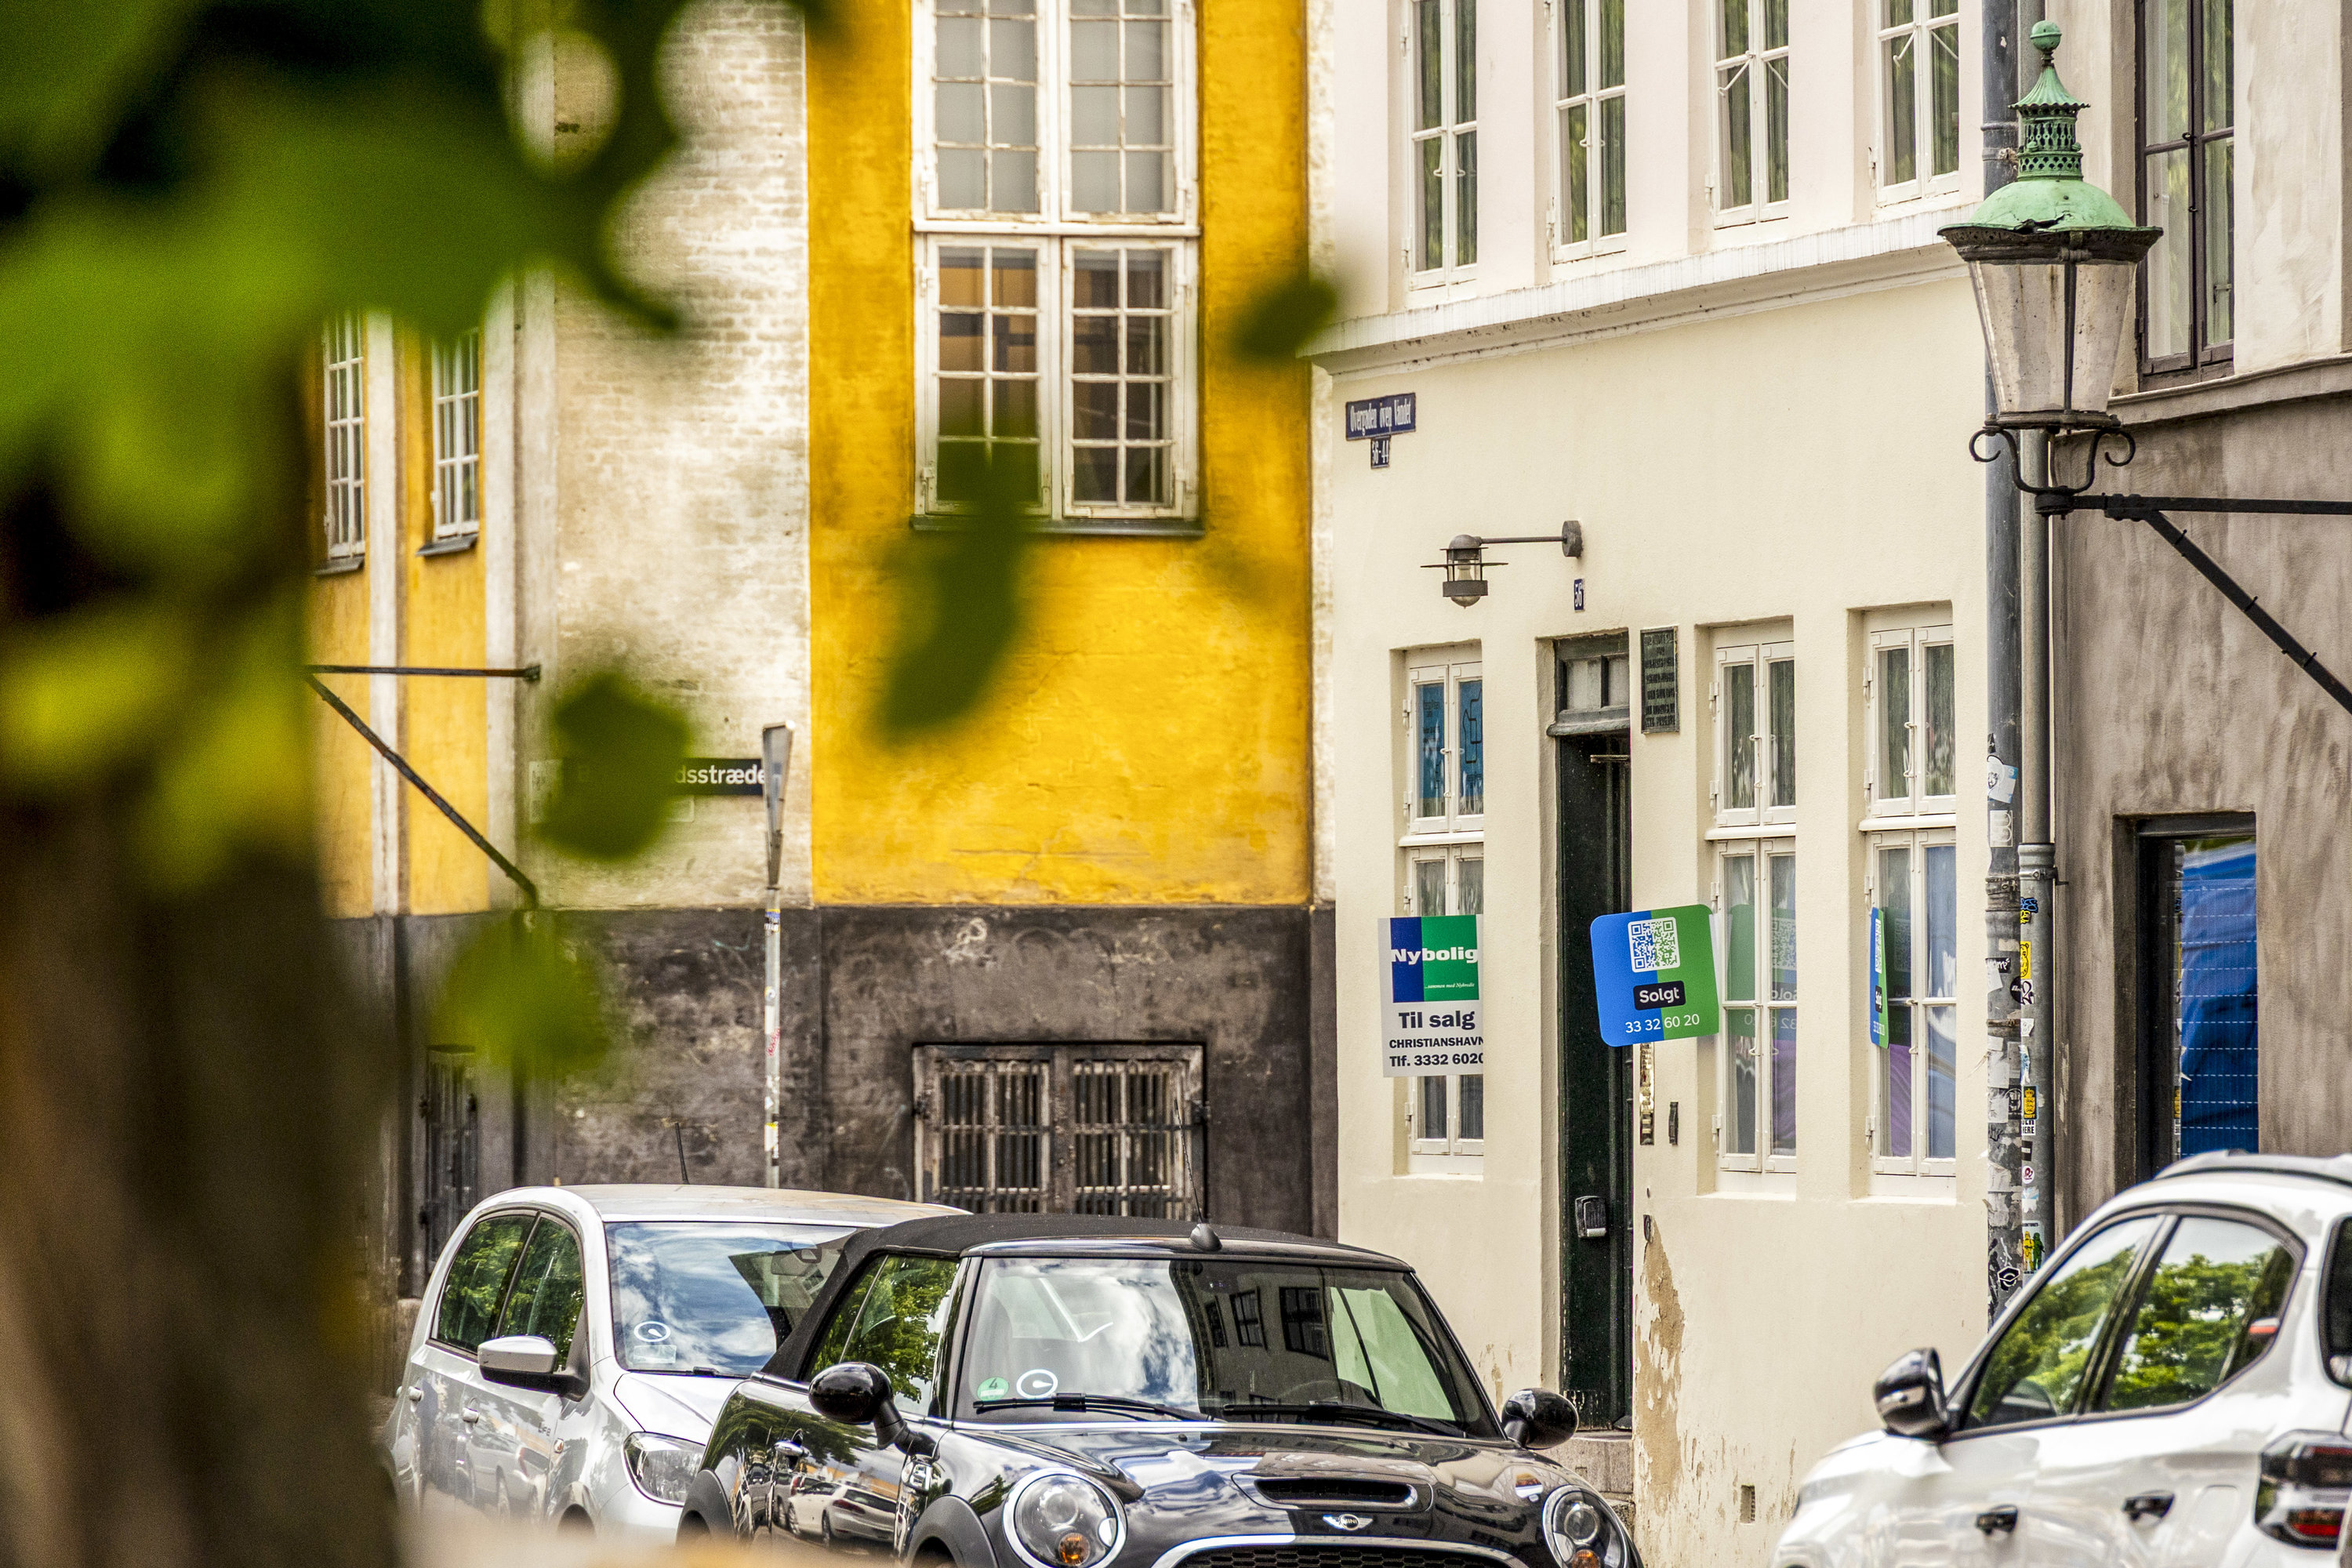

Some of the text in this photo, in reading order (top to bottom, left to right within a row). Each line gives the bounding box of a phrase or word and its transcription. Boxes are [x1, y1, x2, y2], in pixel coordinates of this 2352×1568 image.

[1350, 398, 1411, 436] Overgaden oven Vandet
[1391, 946, 1479, 965] Nybolig
[1639, 987, 1680, 1003] Solgt
[1398, 1011, 1475, 1030] Til salg
[1625, 1014, 1700, 1033] 33 32 60 20
[1389, 1036, 1483, 1049] CHRISTIANSHAVN
[1389, 1055, 1410, 1067] Tlf.
[1414, 1054, 1449, 1065] 3332
[989, 1377, 998, 1389] 4
